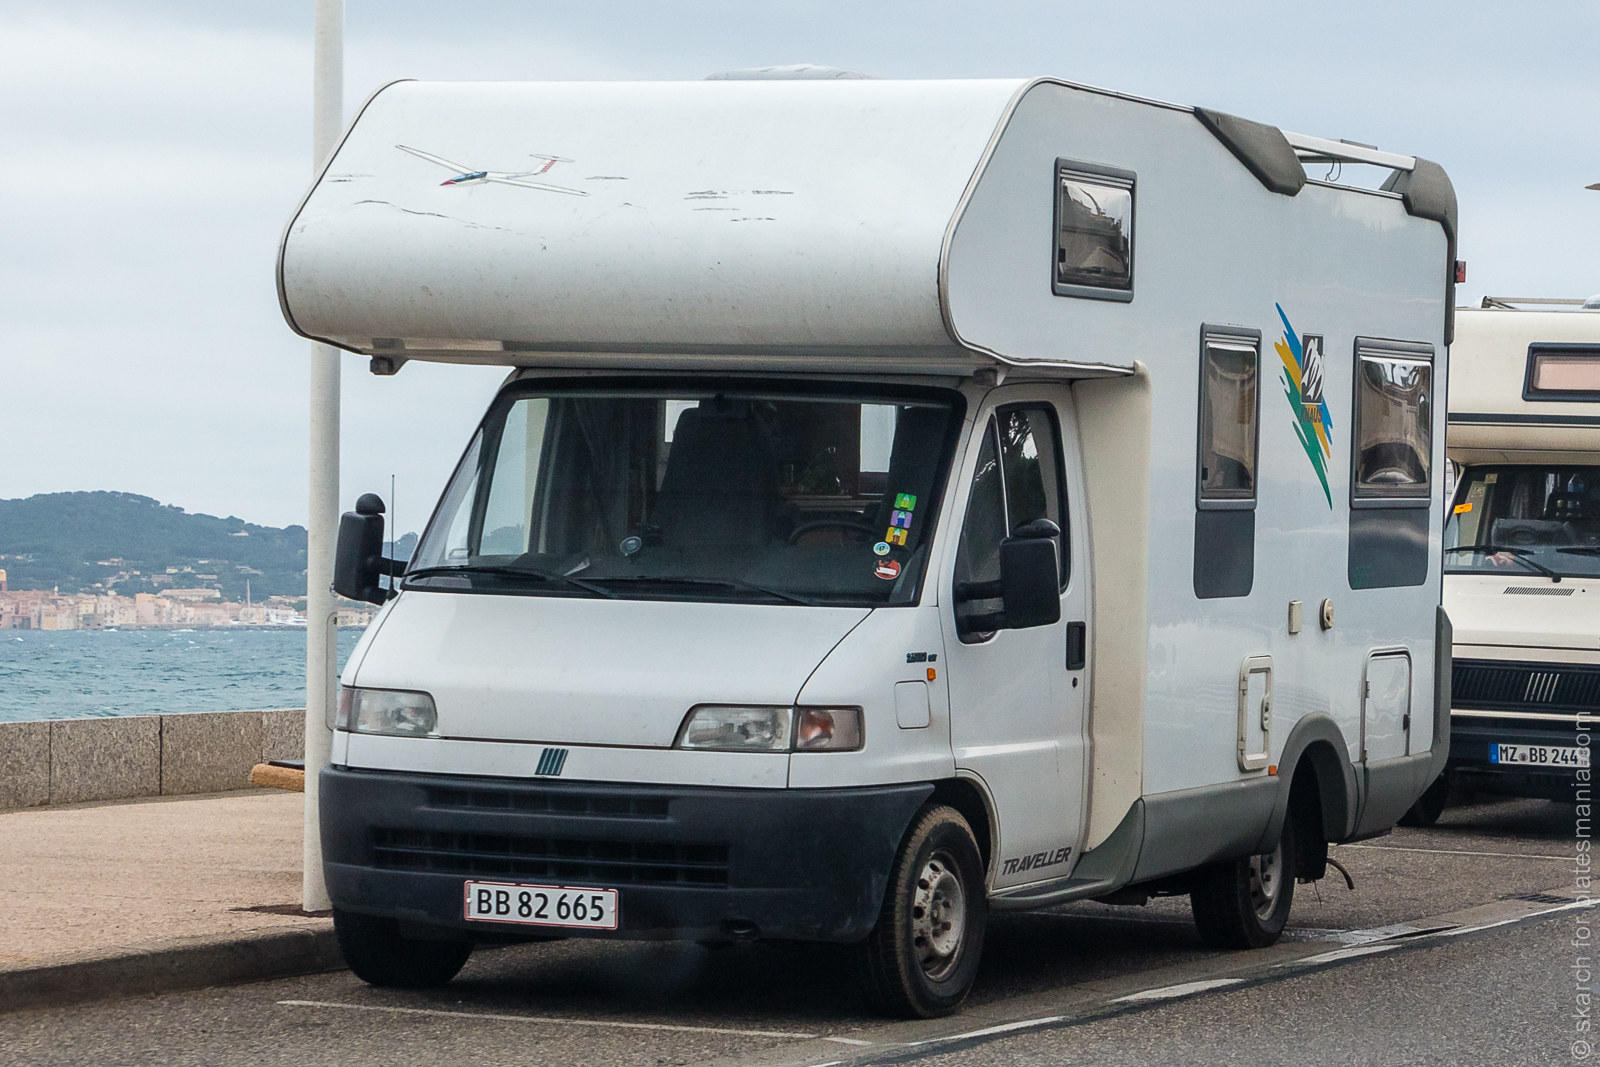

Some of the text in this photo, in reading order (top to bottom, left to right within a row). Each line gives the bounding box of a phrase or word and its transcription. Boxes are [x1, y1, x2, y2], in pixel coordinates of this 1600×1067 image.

[1300, 407, 1323, 423] KNAUS
[1499, 746, 1578, 765] MZ BB 244
[1002, 846, 1072, 875] TRAVELLER
[477, 889, 604, 921] BB 82 665
